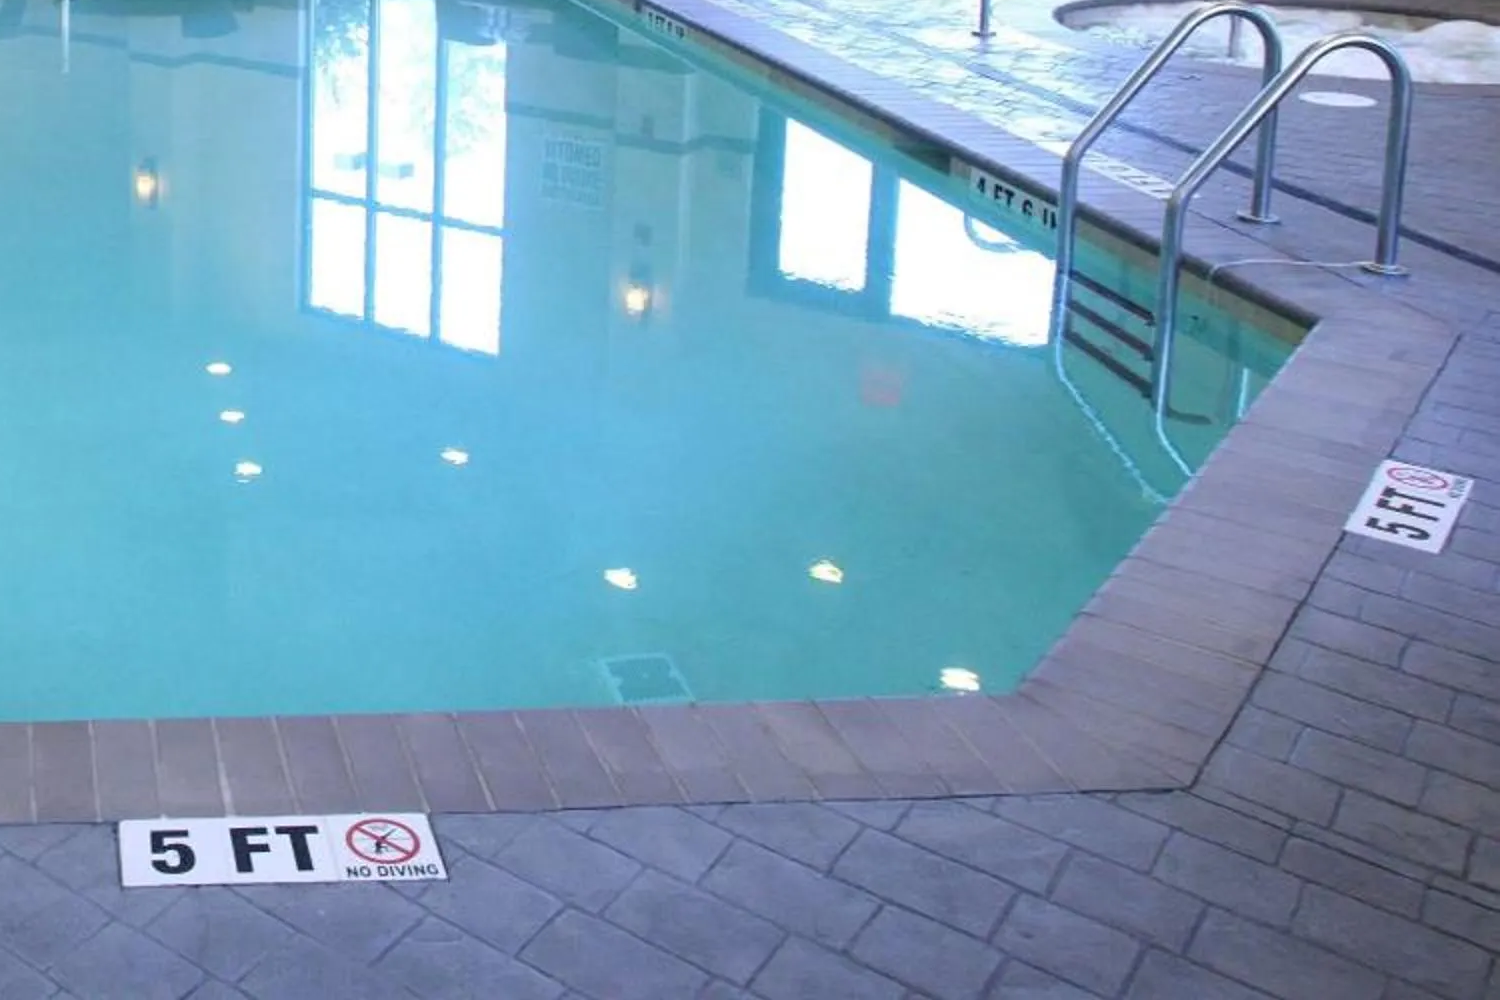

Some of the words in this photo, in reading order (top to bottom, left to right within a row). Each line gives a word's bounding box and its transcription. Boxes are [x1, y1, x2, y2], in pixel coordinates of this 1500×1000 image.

[1374, 486, 1446, 522] FT
[1365, 516, 1431, 541] 5
[150, 829, 196, 875] 5
[229, 825, 319, 874] FT
[346, 865, 372, 877] NO
[377, 863, 440, 877] DIVING
